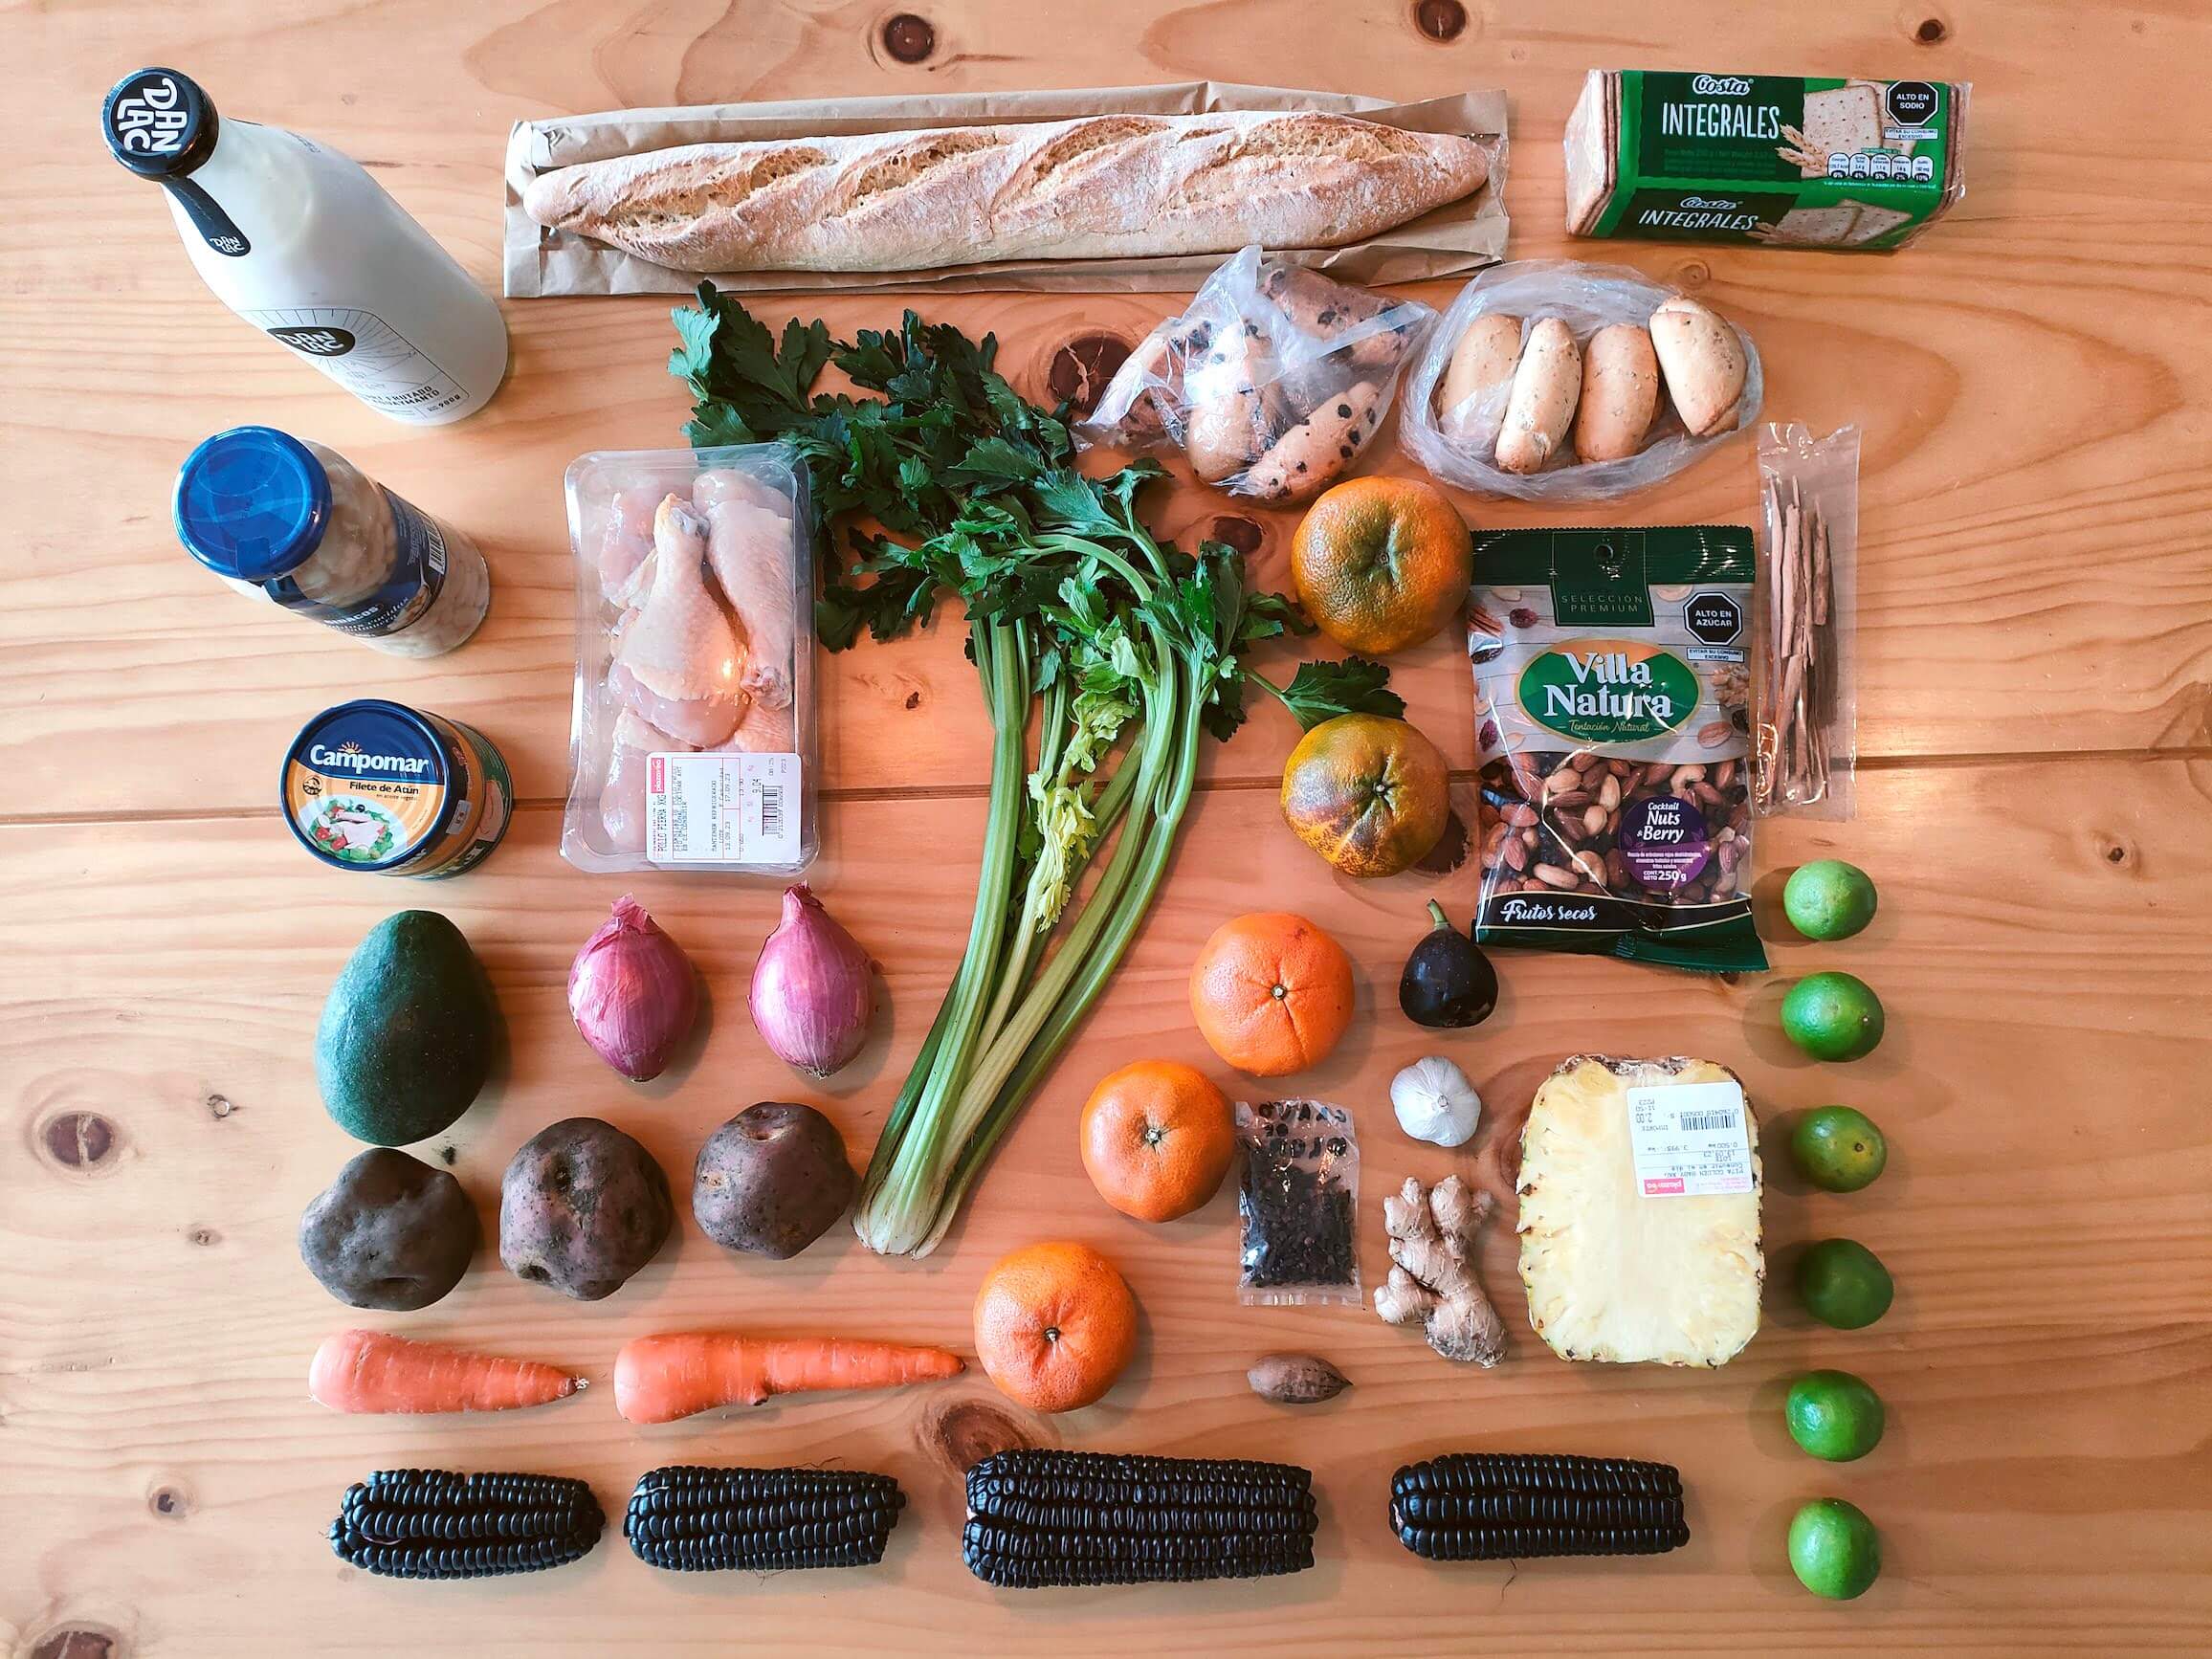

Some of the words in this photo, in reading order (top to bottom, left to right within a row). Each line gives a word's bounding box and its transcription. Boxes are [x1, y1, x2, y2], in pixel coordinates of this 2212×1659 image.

[1692, 75, 1750, 96] Costa
[143, 77, 188, 151] DAN
[1662, 102, 1780, 140] INTEGRALES
[117, 99, 154, 151] LAC
[1639, 210, 1759, 231] INTEGRALES
[1570, 604, 1638, 612] PREMIUM
[1560, 653, 1653, 685] Villa
[1542, 684, 1674, 719] Natura
[310, 744, 429, 775] Campomar
[350, 781, 376, 792] Filete
[379, 784, 391, 793] de
[1648, 802, 1679, 810] Cocktail
[1647, 810, 1681, 826] Nuts
[1643, 825, 1684, 844] Berry
[1658, 871, 1680, 881] 250
[1499, 899, 1556, 922] Frutos
[1558, 905, 1598, 920] secos
